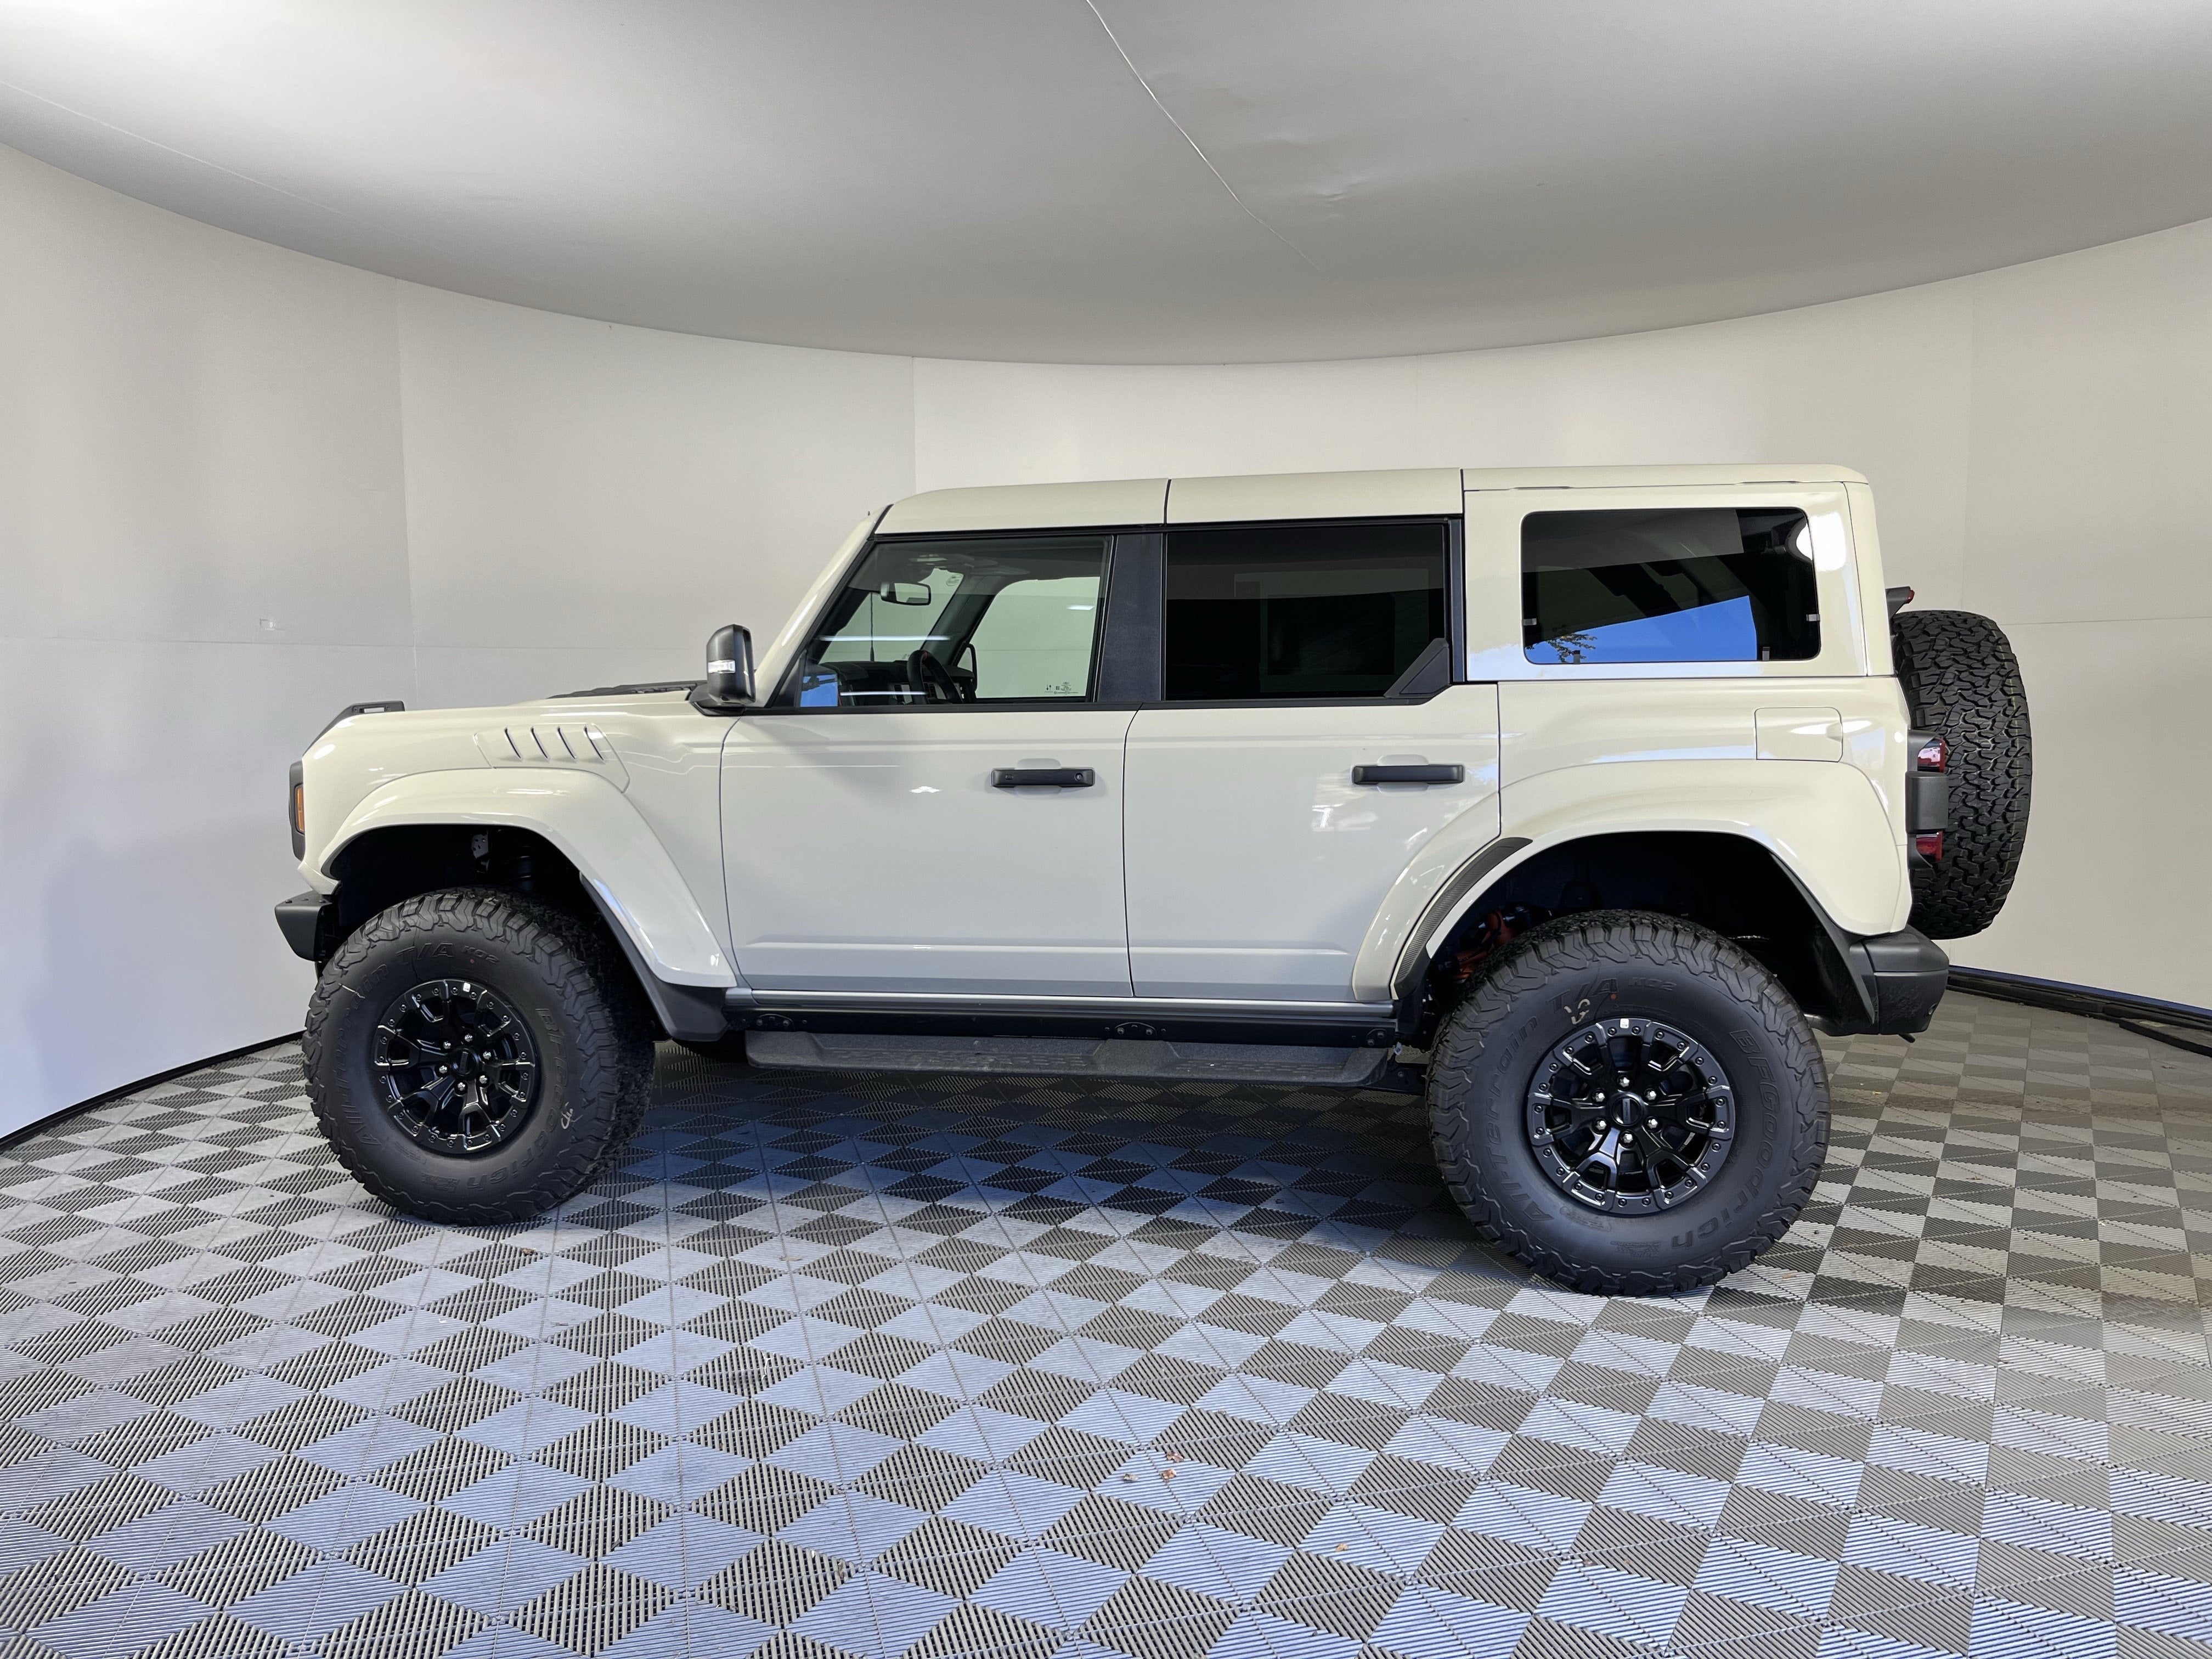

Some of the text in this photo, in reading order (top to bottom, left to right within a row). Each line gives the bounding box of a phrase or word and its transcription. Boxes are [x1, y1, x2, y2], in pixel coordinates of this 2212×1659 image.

[397, 942, 454, 966] T/A
[1487, 1015, 1555, 1220] All-Terrain
[1546, 979, 1617, 1013] T/A
[1672, 1029, 1780, 1249] BFGoodrich
